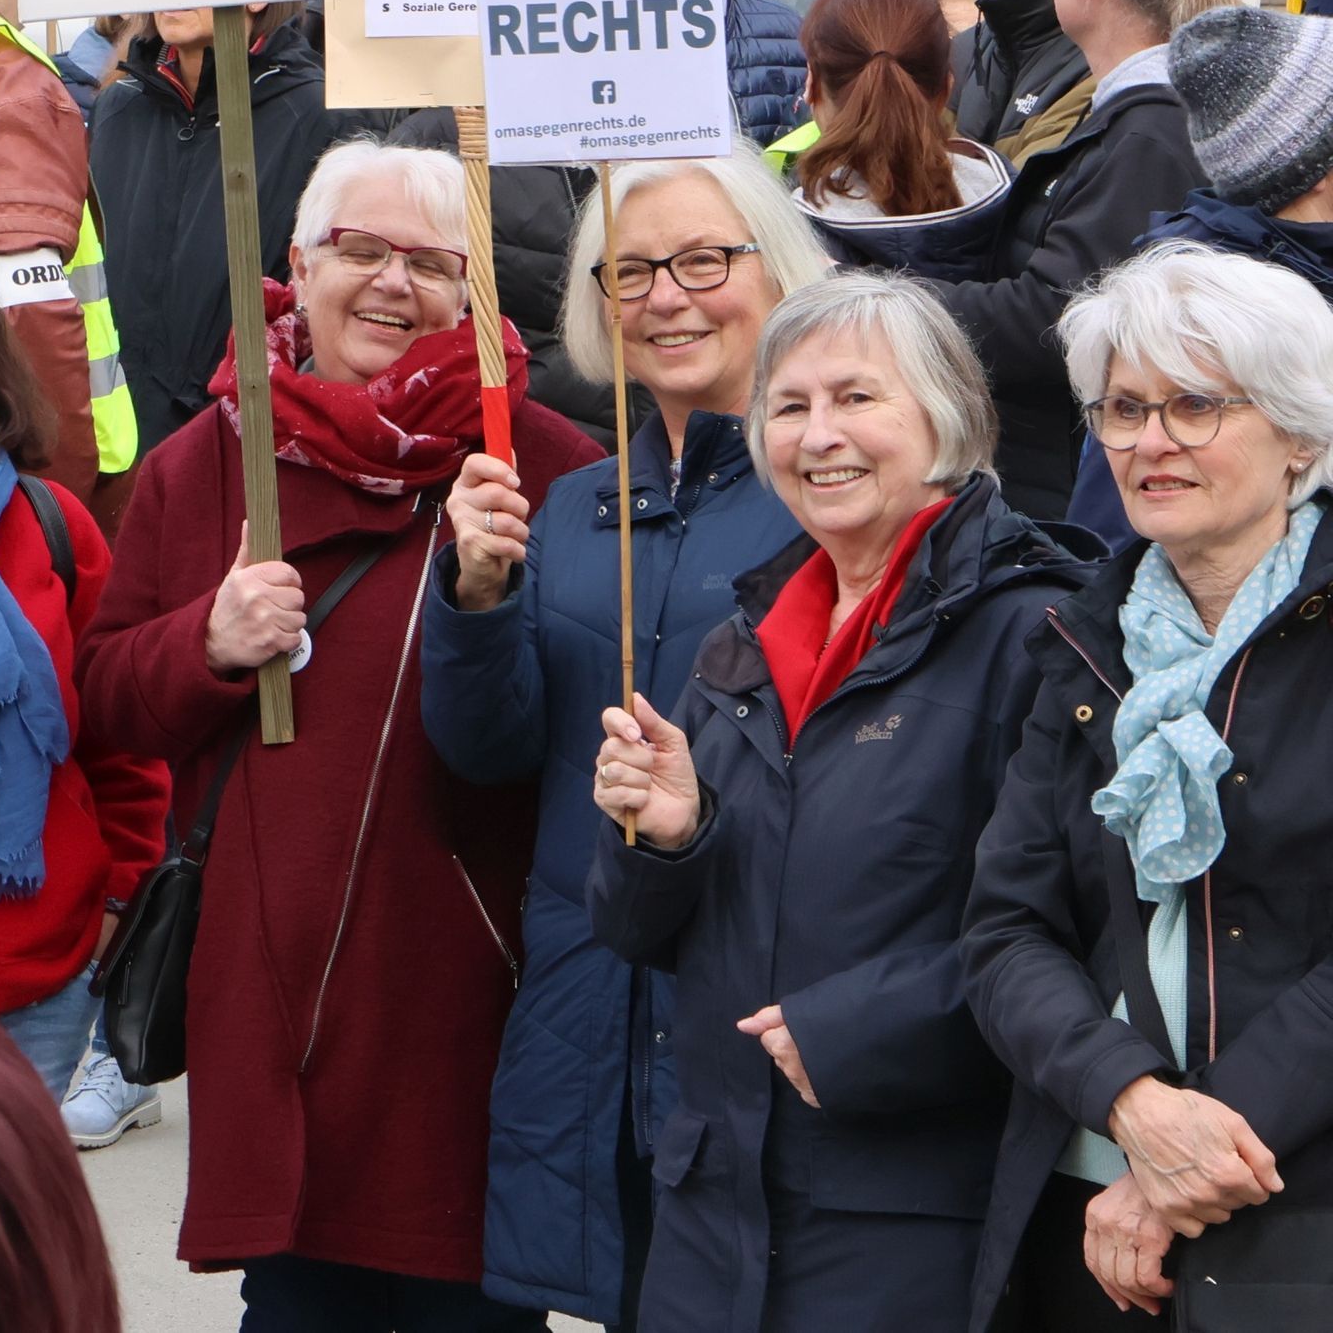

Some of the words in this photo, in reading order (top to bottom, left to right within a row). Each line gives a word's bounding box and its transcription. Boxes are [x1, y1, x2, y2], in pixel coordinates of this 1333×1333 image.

[382, 3, 390, 12] S
[403, 3, 445, 12] Soziale
[494, 114, 647, 140] omasgegenrechts.de
[579, 126, 721, 150] #omasgegenrechts
